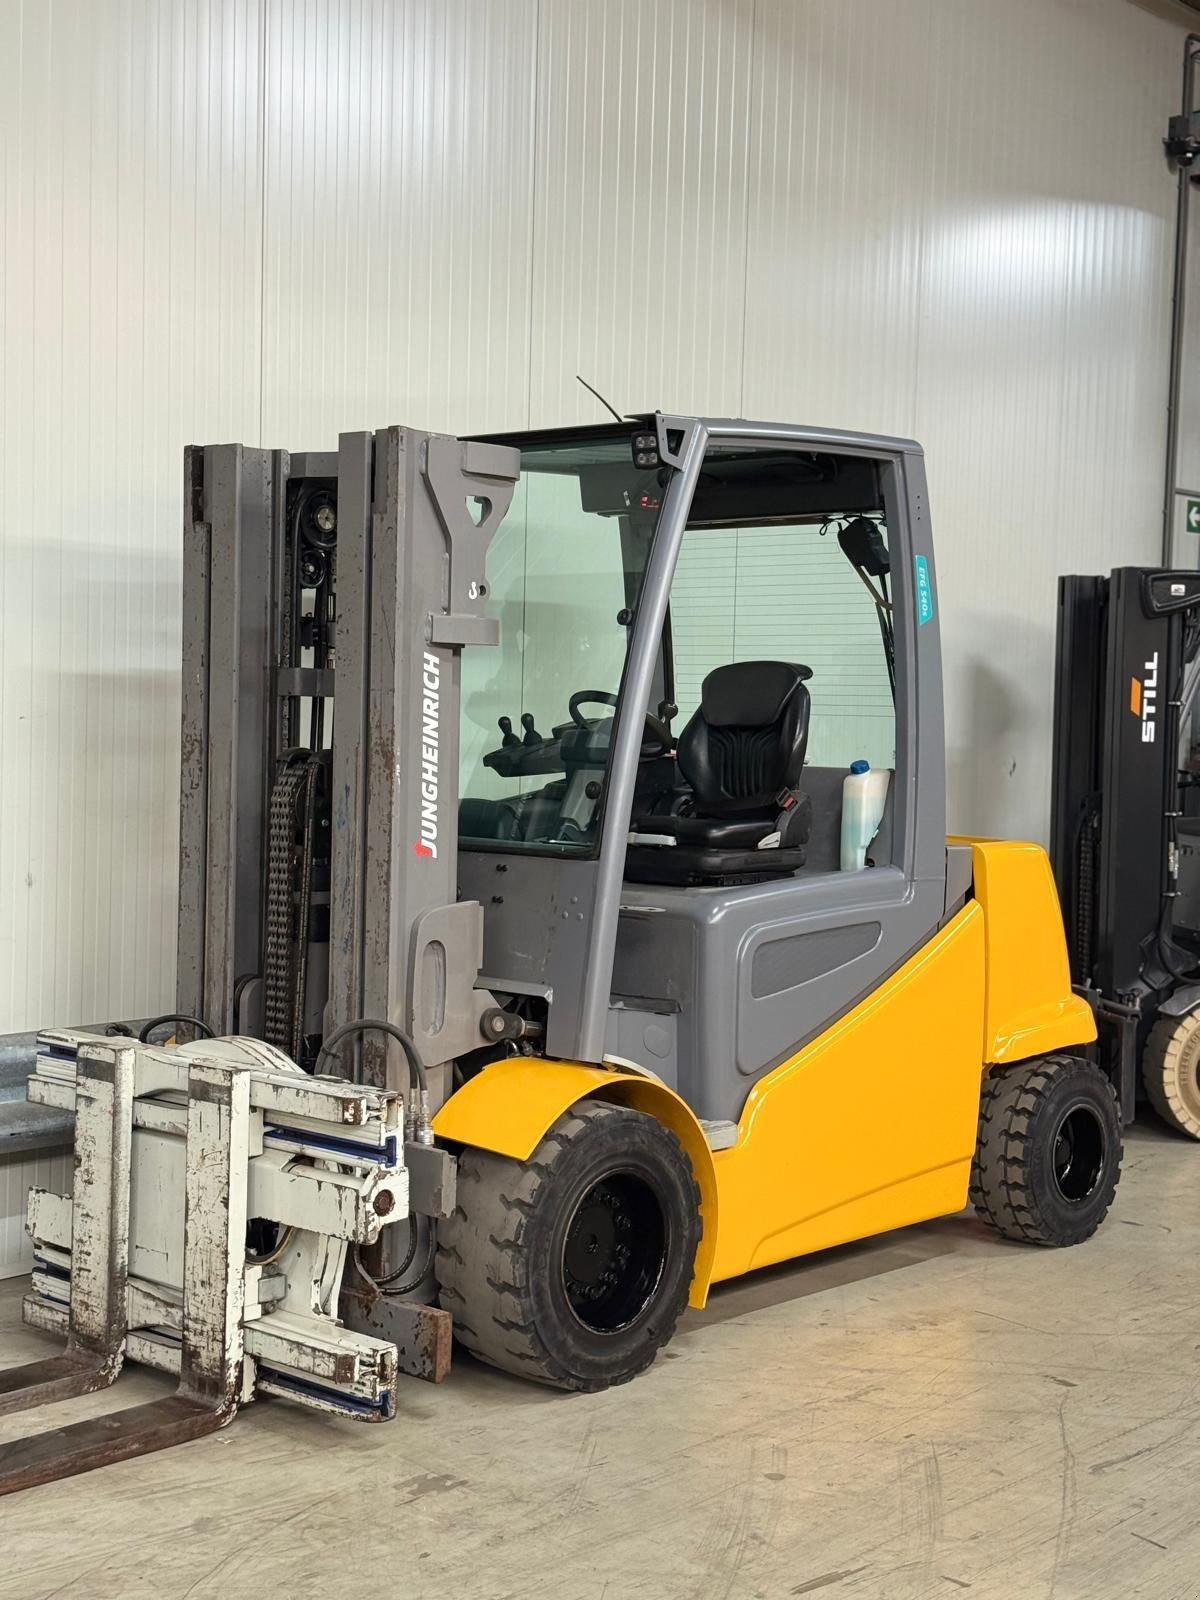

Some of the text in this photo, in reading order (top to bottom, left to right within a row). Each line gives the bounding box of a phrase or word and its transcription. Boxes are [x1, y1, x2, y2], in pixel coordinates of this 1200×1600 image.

[919, 567, 928, 587] EFG
[1141, 651, 1159, 743] STILL
[416, 652, 440, 858] JUNGHEINRICH
